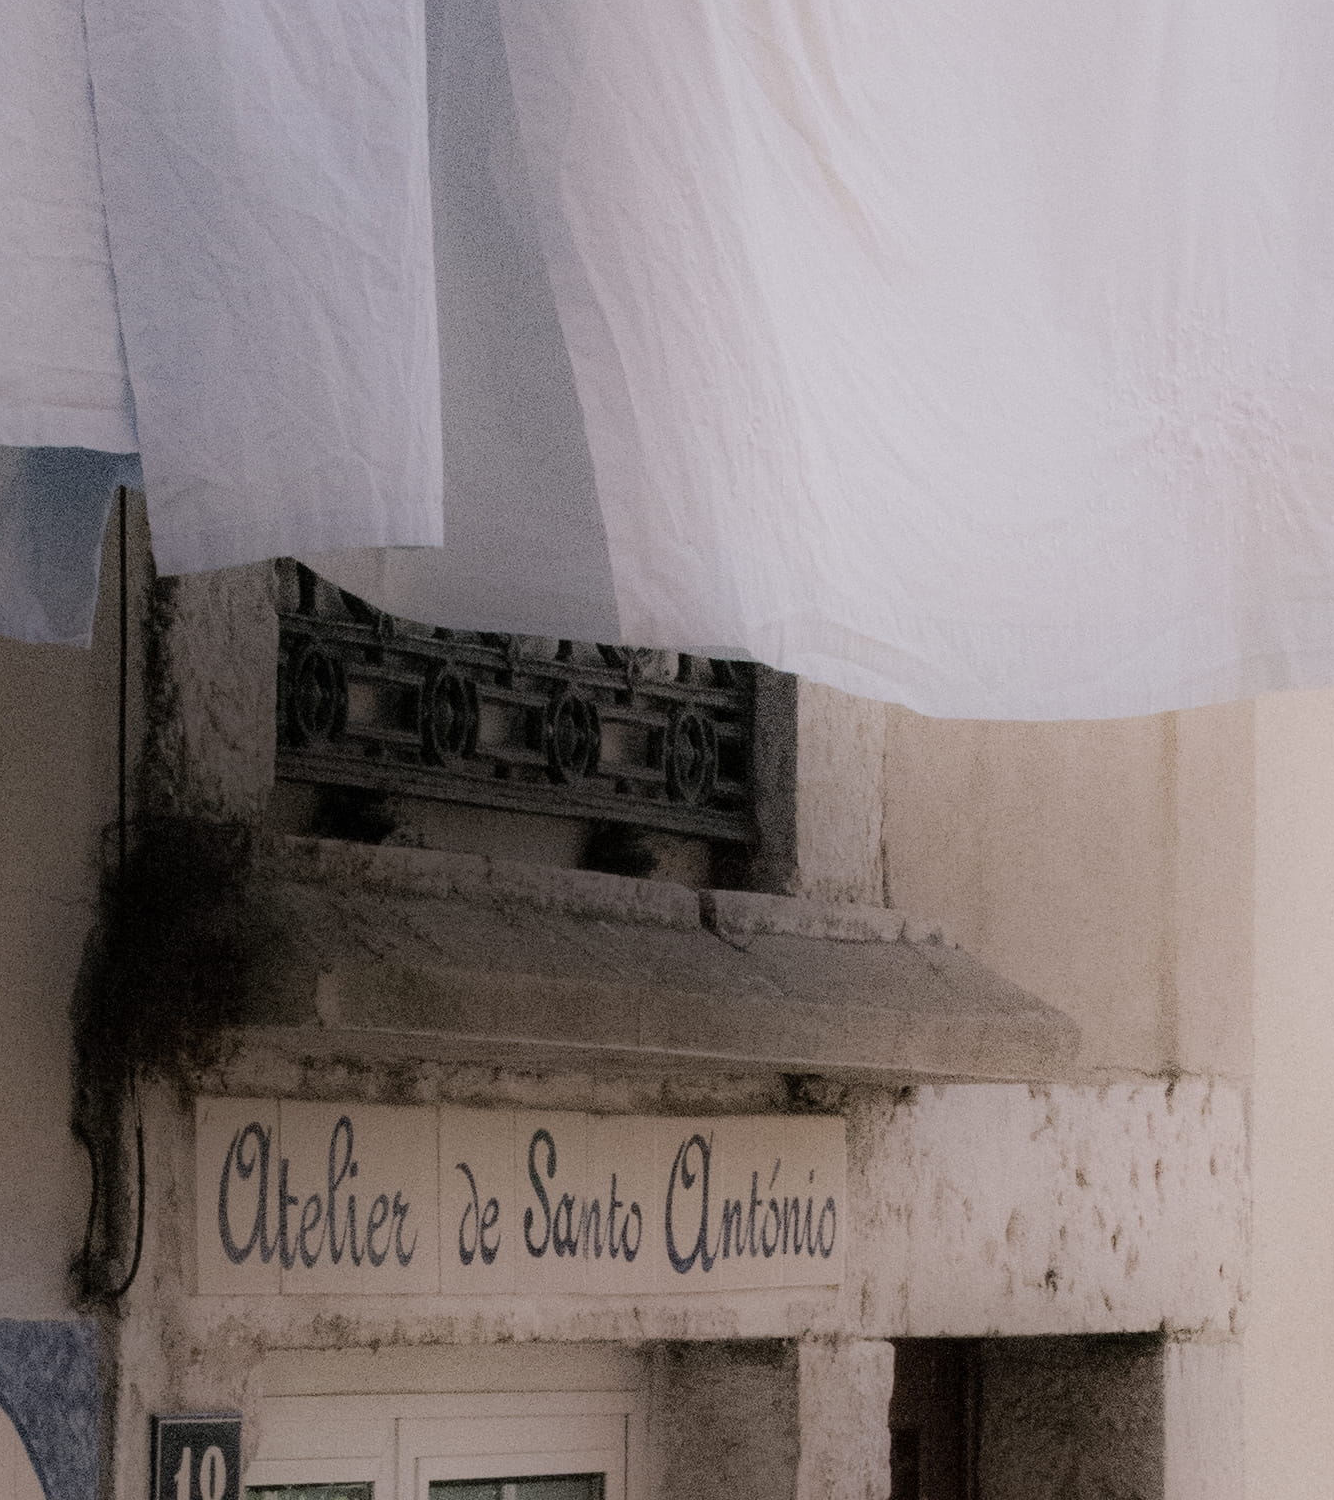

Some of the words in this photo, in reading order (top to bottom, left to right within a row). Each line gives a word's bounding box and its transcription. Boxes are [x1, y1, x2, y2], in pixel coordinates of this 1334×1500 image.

[218, 1116, 418, 1269] Atelier
[457, 1162, 501, 1266] de
[524, 1128, 643, 1264] Santo
[667, 1130, 836, 1274] António
